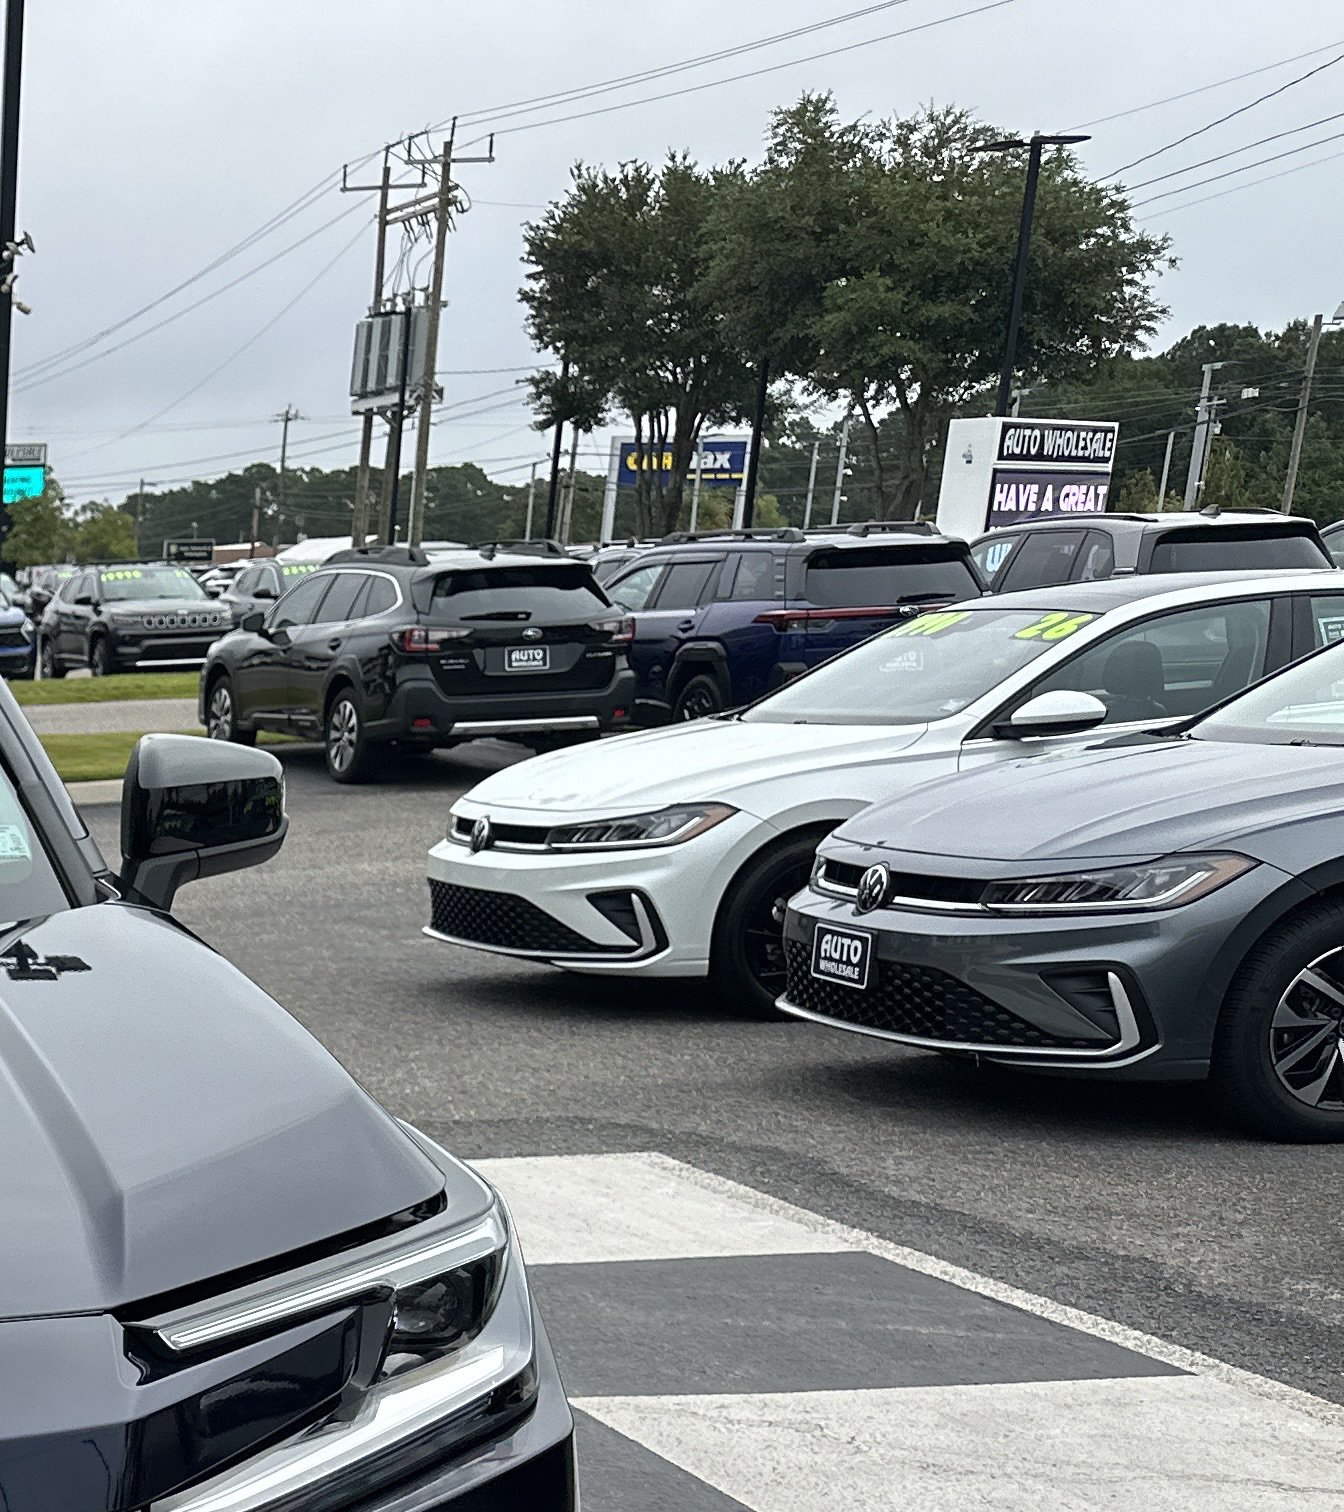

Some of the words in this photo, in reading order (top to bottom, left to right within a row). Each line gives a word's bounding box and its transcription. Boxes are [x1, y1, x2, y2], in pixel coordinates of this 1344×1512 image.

[1003, 428, 1040, 456] AUTO
[1043, 429, 1112, 459] WHOLESALE
[993, 484, 1038, 511] HAVE
[1040, 484, 1053, 511] A
[1059, 485, 1107, 511] GREAT
[1014, 611, 1095, 641] 26
[511, 648, 544, 662] AUTO
[820, 933, 862, 964] AUTO
[819, 959, 860, 979] WHOLESALE
